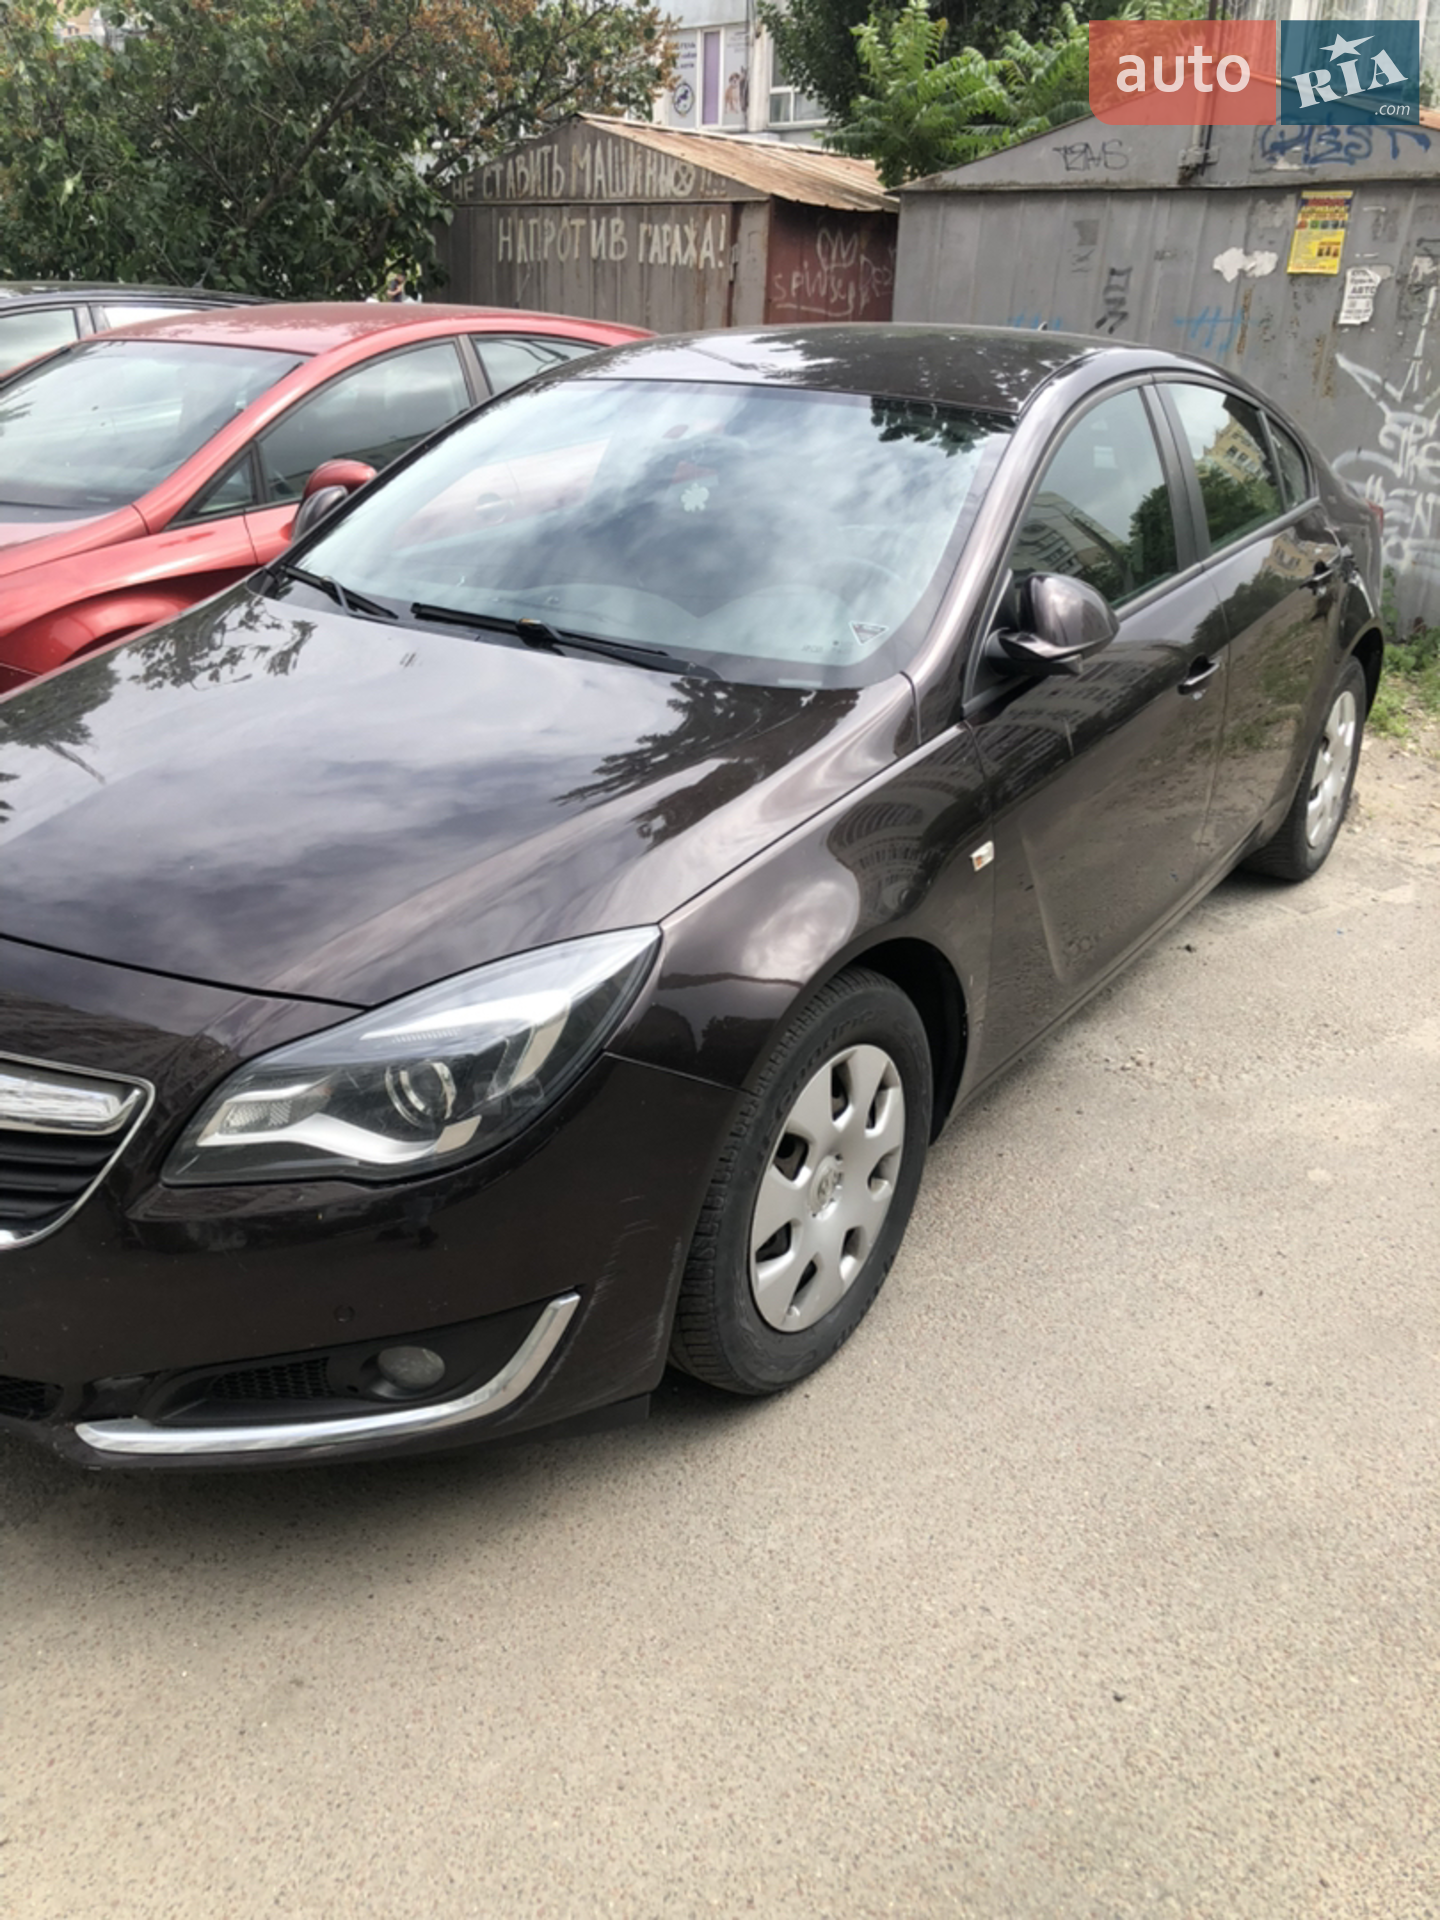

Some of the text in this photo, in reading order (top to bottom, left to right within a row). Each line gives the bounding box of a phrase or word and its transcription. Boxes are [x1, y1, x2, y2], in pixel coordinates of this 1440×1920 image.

[452, 176, 475, 200] НЕ
[482, 143, 566, 199] СТАВИТЬ
[497, 216, 628, 263] НАПРОТИВ
